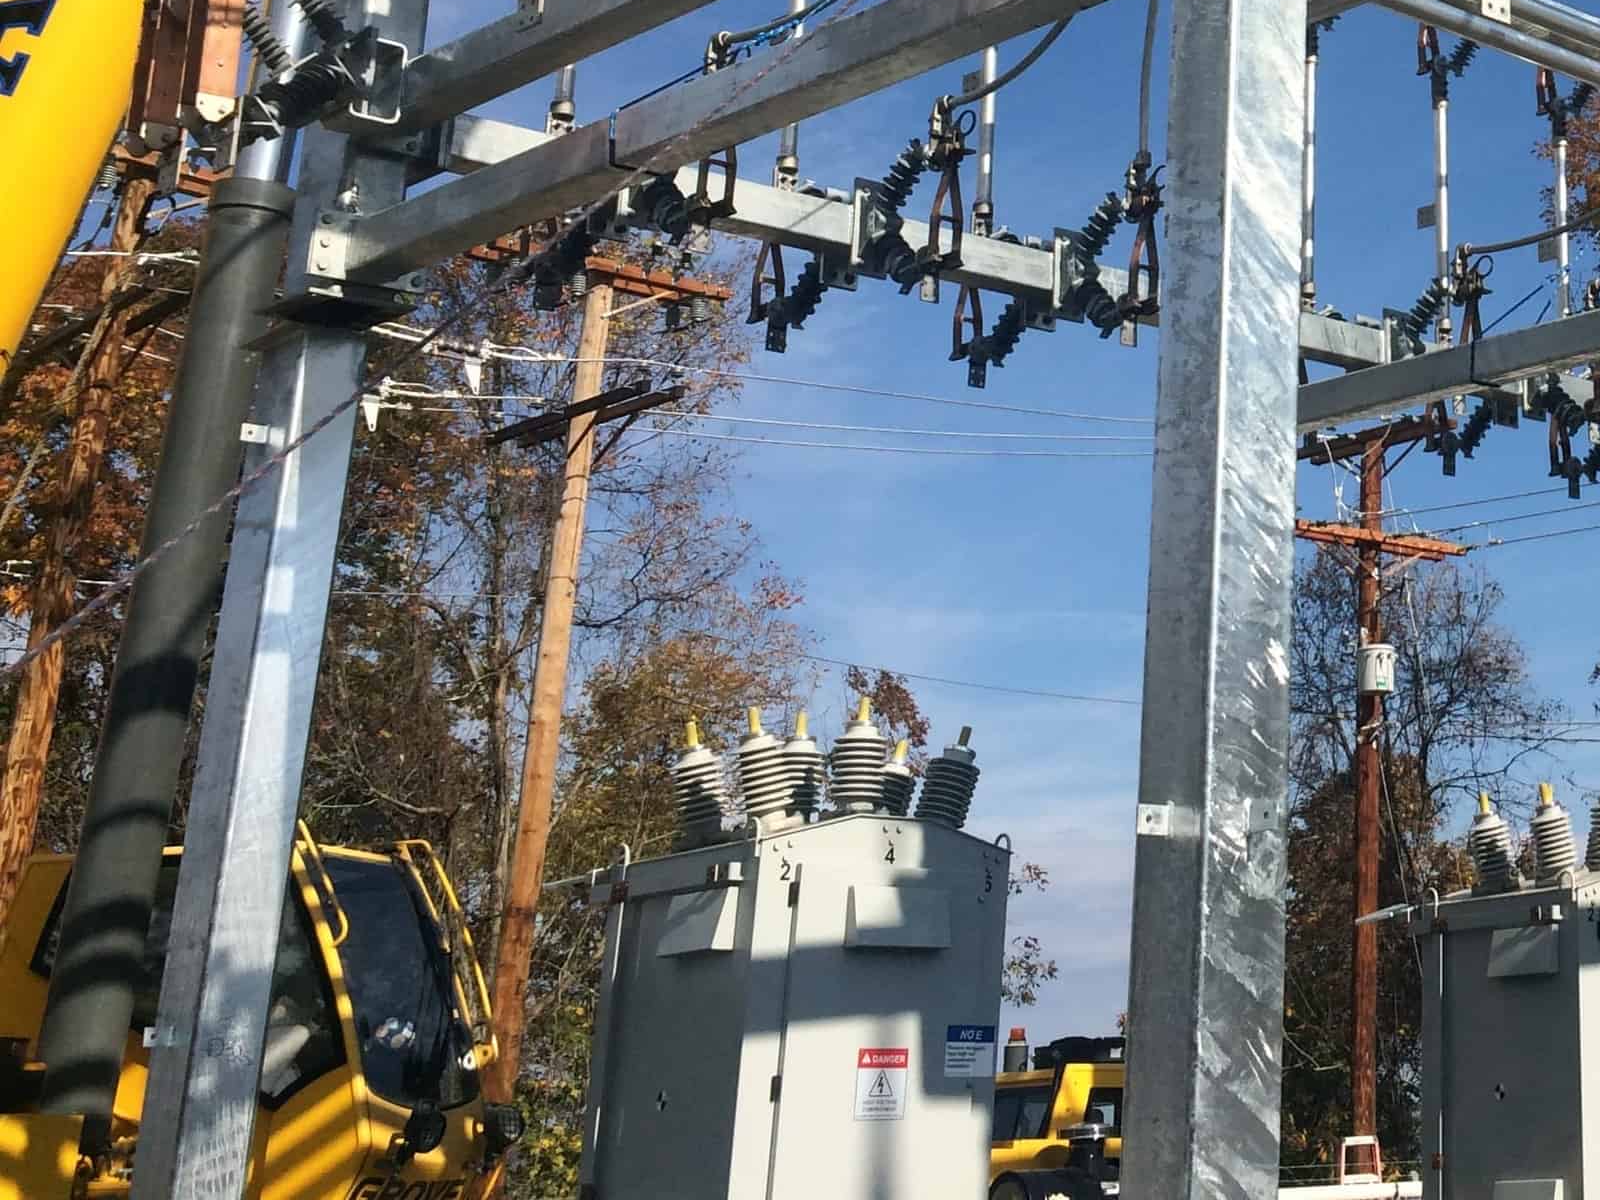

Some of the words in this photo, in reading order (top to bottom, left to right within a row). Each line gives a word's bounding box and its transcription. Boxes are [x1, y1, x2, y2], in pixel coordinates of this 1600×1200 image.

[884, 847, 896, 865] 4
[780, 862, 791, 881] 2
[872, 1054, 906, 1064] DANGER
